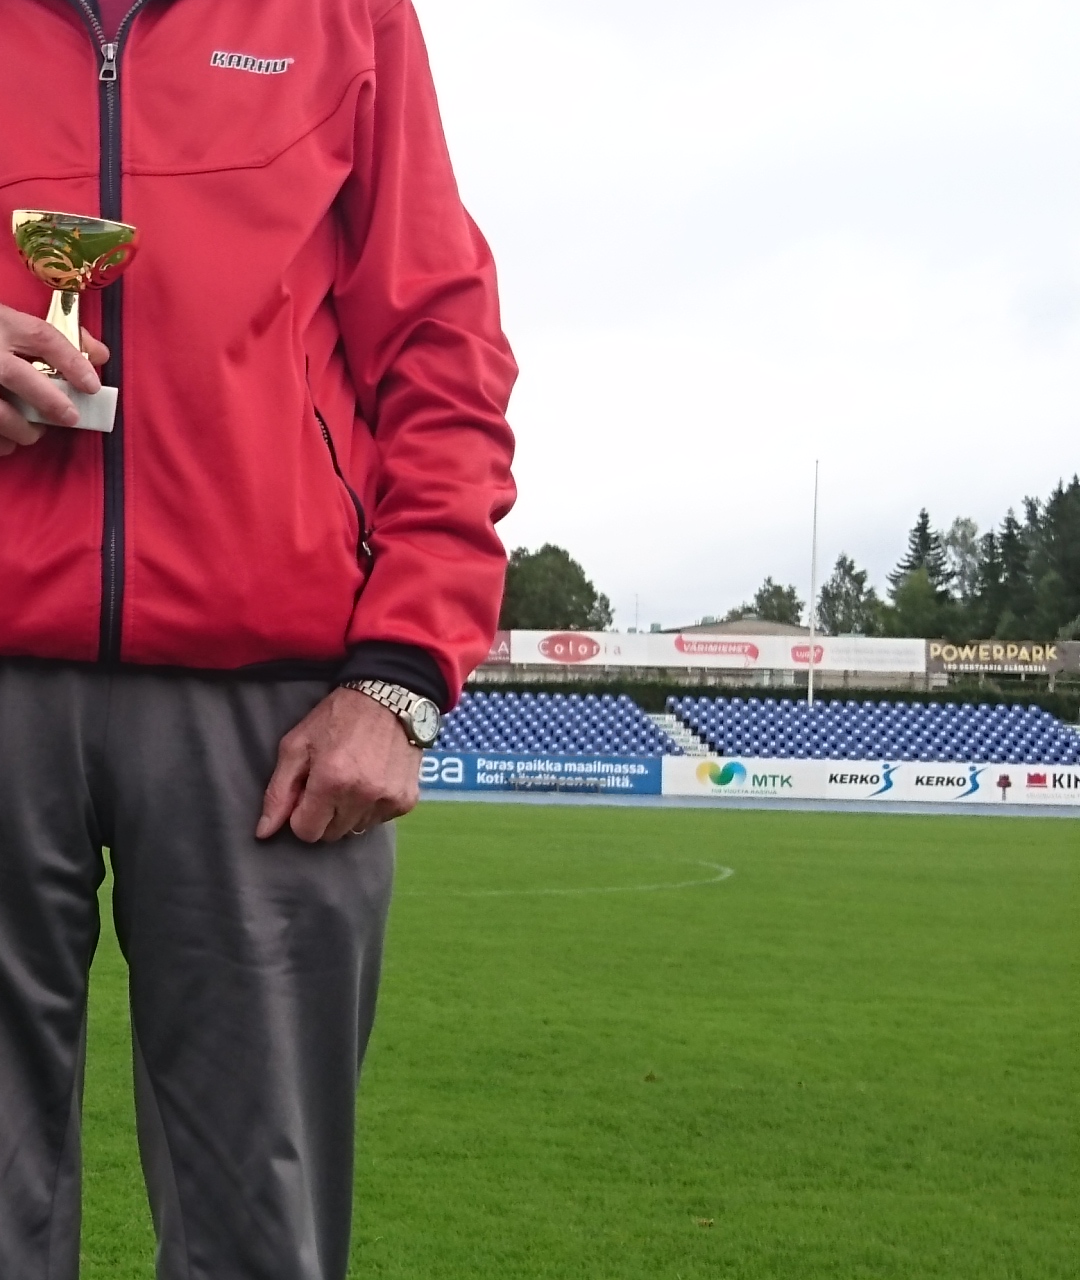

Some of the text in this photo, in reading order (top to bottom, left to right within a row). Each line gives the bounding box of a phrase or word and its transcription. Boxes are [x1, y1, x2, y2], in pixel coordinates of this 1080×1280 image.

[210, 51, 288, 74] KARHU
[538, 641, 621, 656] Coloria
[929, 643, 1058, 662] POWERPARK
[476, 758, 649, 775] Paras paikka maailmassa.
[476, 772, 507, 784] Koti.
[752, 774, 793, 788] MTK
[828, 773, 880, 785] KERKO
[915, 775, 967, 787] KERKO
